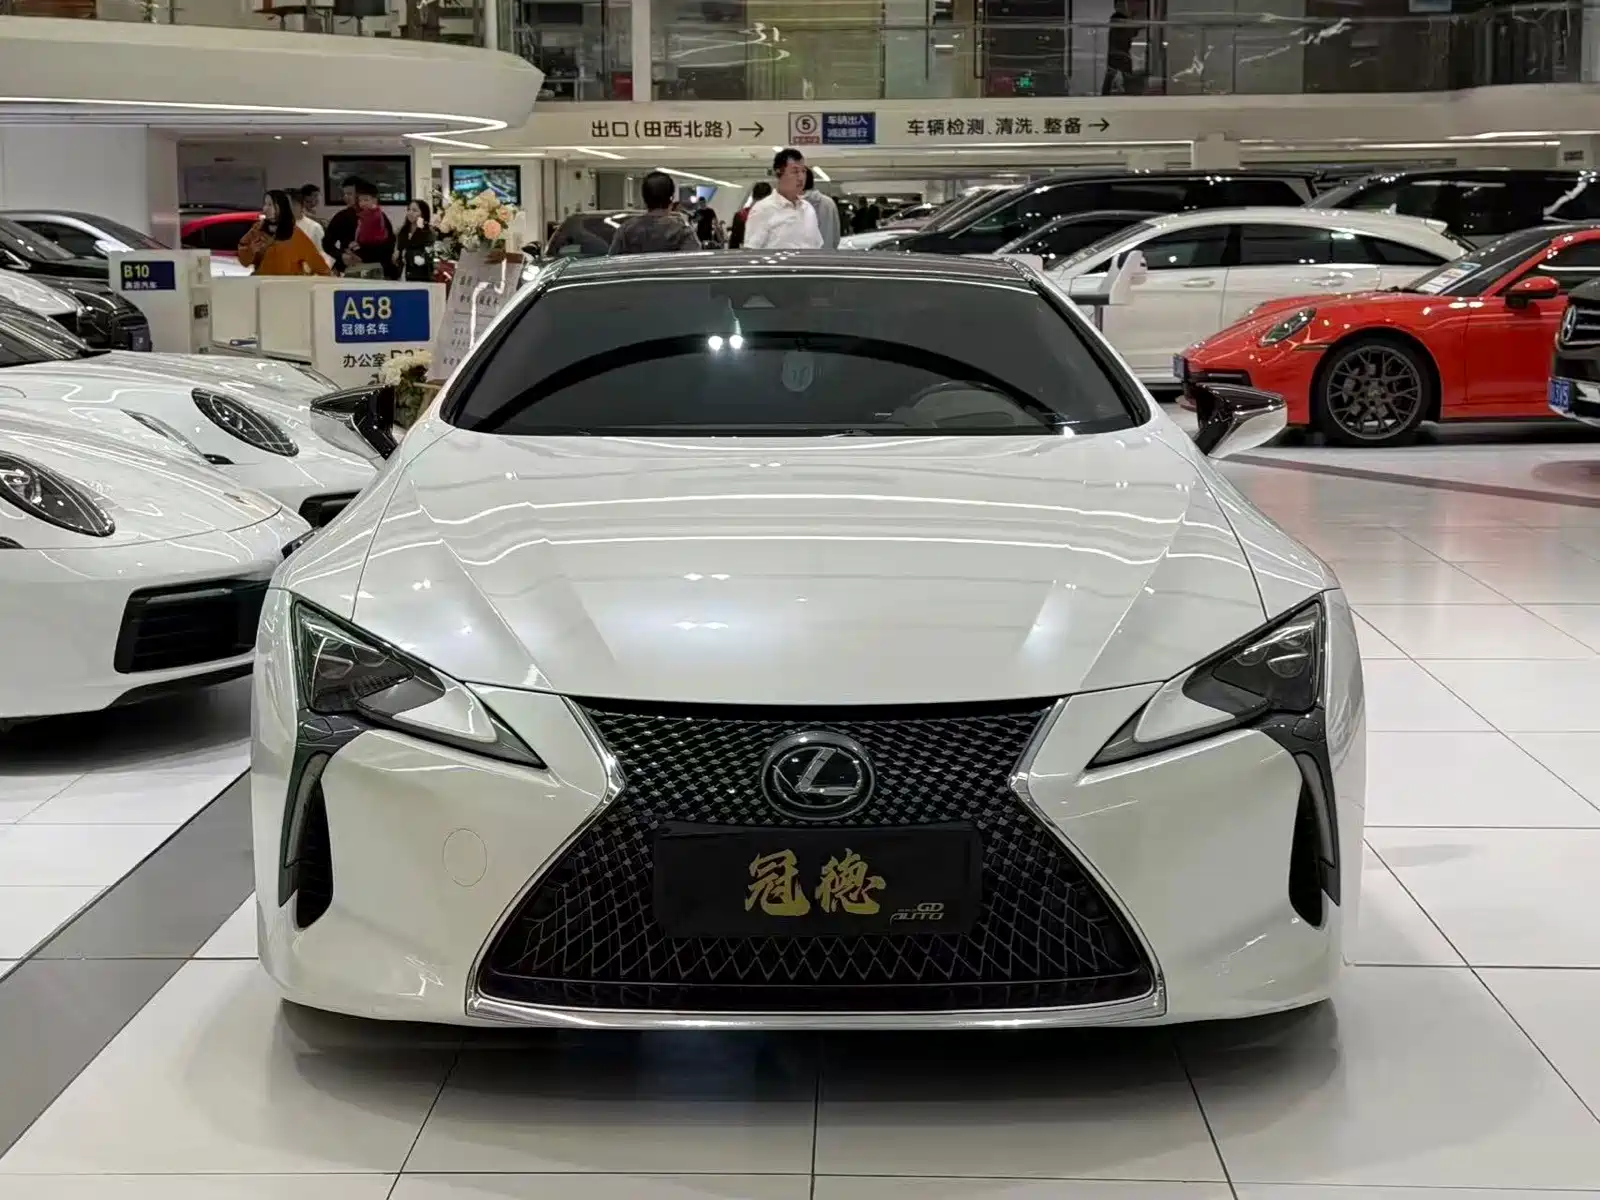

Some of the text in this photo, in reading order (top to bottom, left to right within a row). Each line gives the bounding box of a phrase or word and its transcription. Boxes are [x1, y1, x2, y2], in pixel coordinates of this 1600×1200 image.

[591, 120, 733, 138] 出口（田西北路）
[801, 118, 812, 131] 5
[907, 117, 1082, 136] 车辆检测、清洗、整备
[123, 264, 150, 278] B10
[342, 296, 392, 319] A58
[341, 323, 389, 335] 冠德名车
[343, 353, 386, 368] 办公室
[744, 847, 887, 917] 冠德
[889, 912, 945, 926] AUTO
